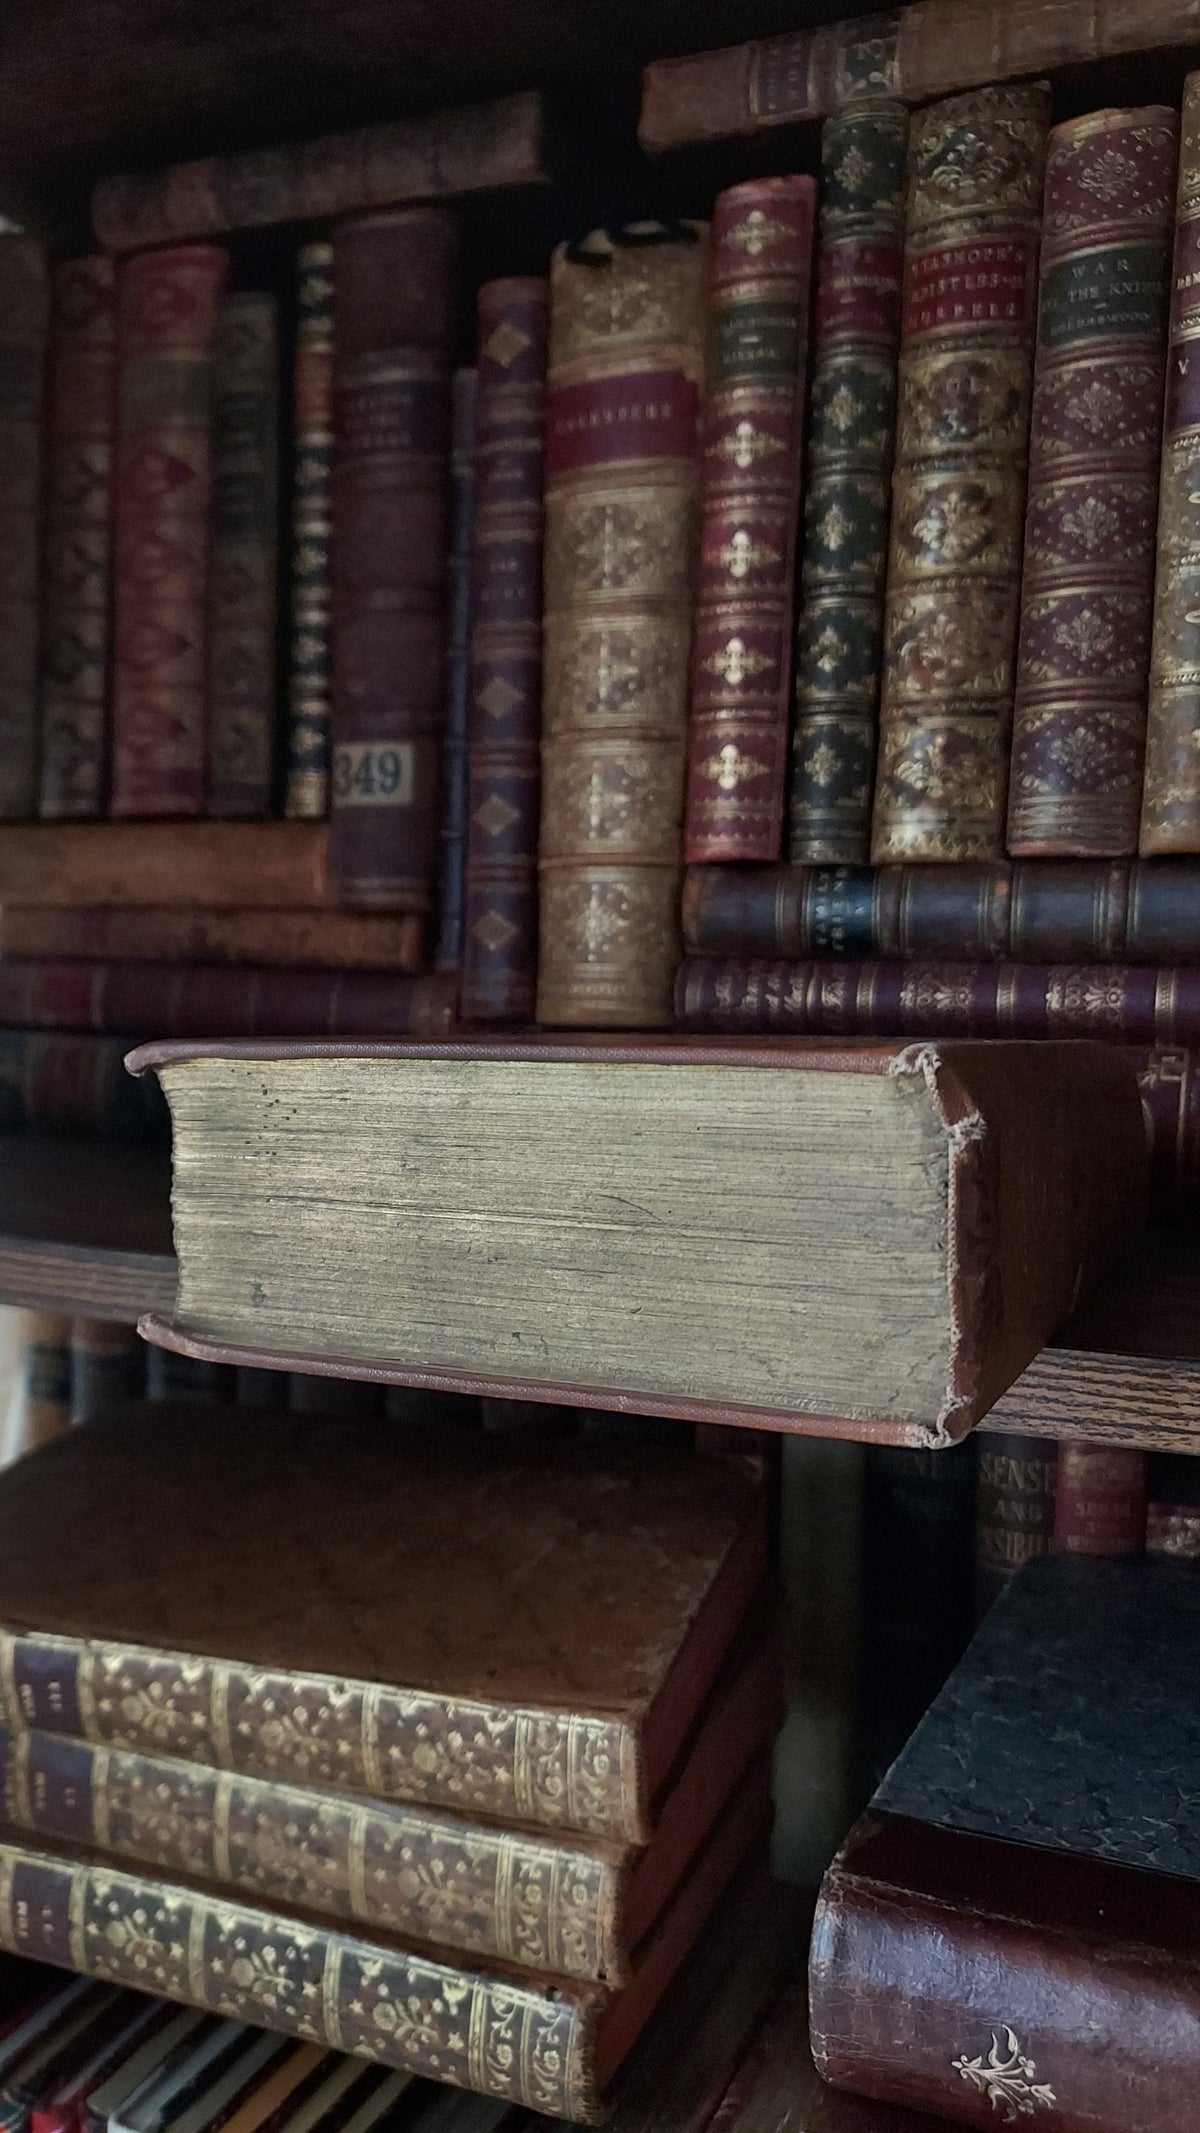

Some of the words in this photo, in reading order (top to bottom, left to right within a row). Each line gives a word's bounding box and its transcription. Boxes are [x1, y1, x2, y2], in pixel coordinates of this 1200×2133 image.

[1072, 259, 1128, 278] WAR
[1068, 286, 1098, 303] THE
[336, 750, 401, 798] 349
[979, 1452, 1057, 1492] SENSE
[994, 1499, 1043, 1523] AND
